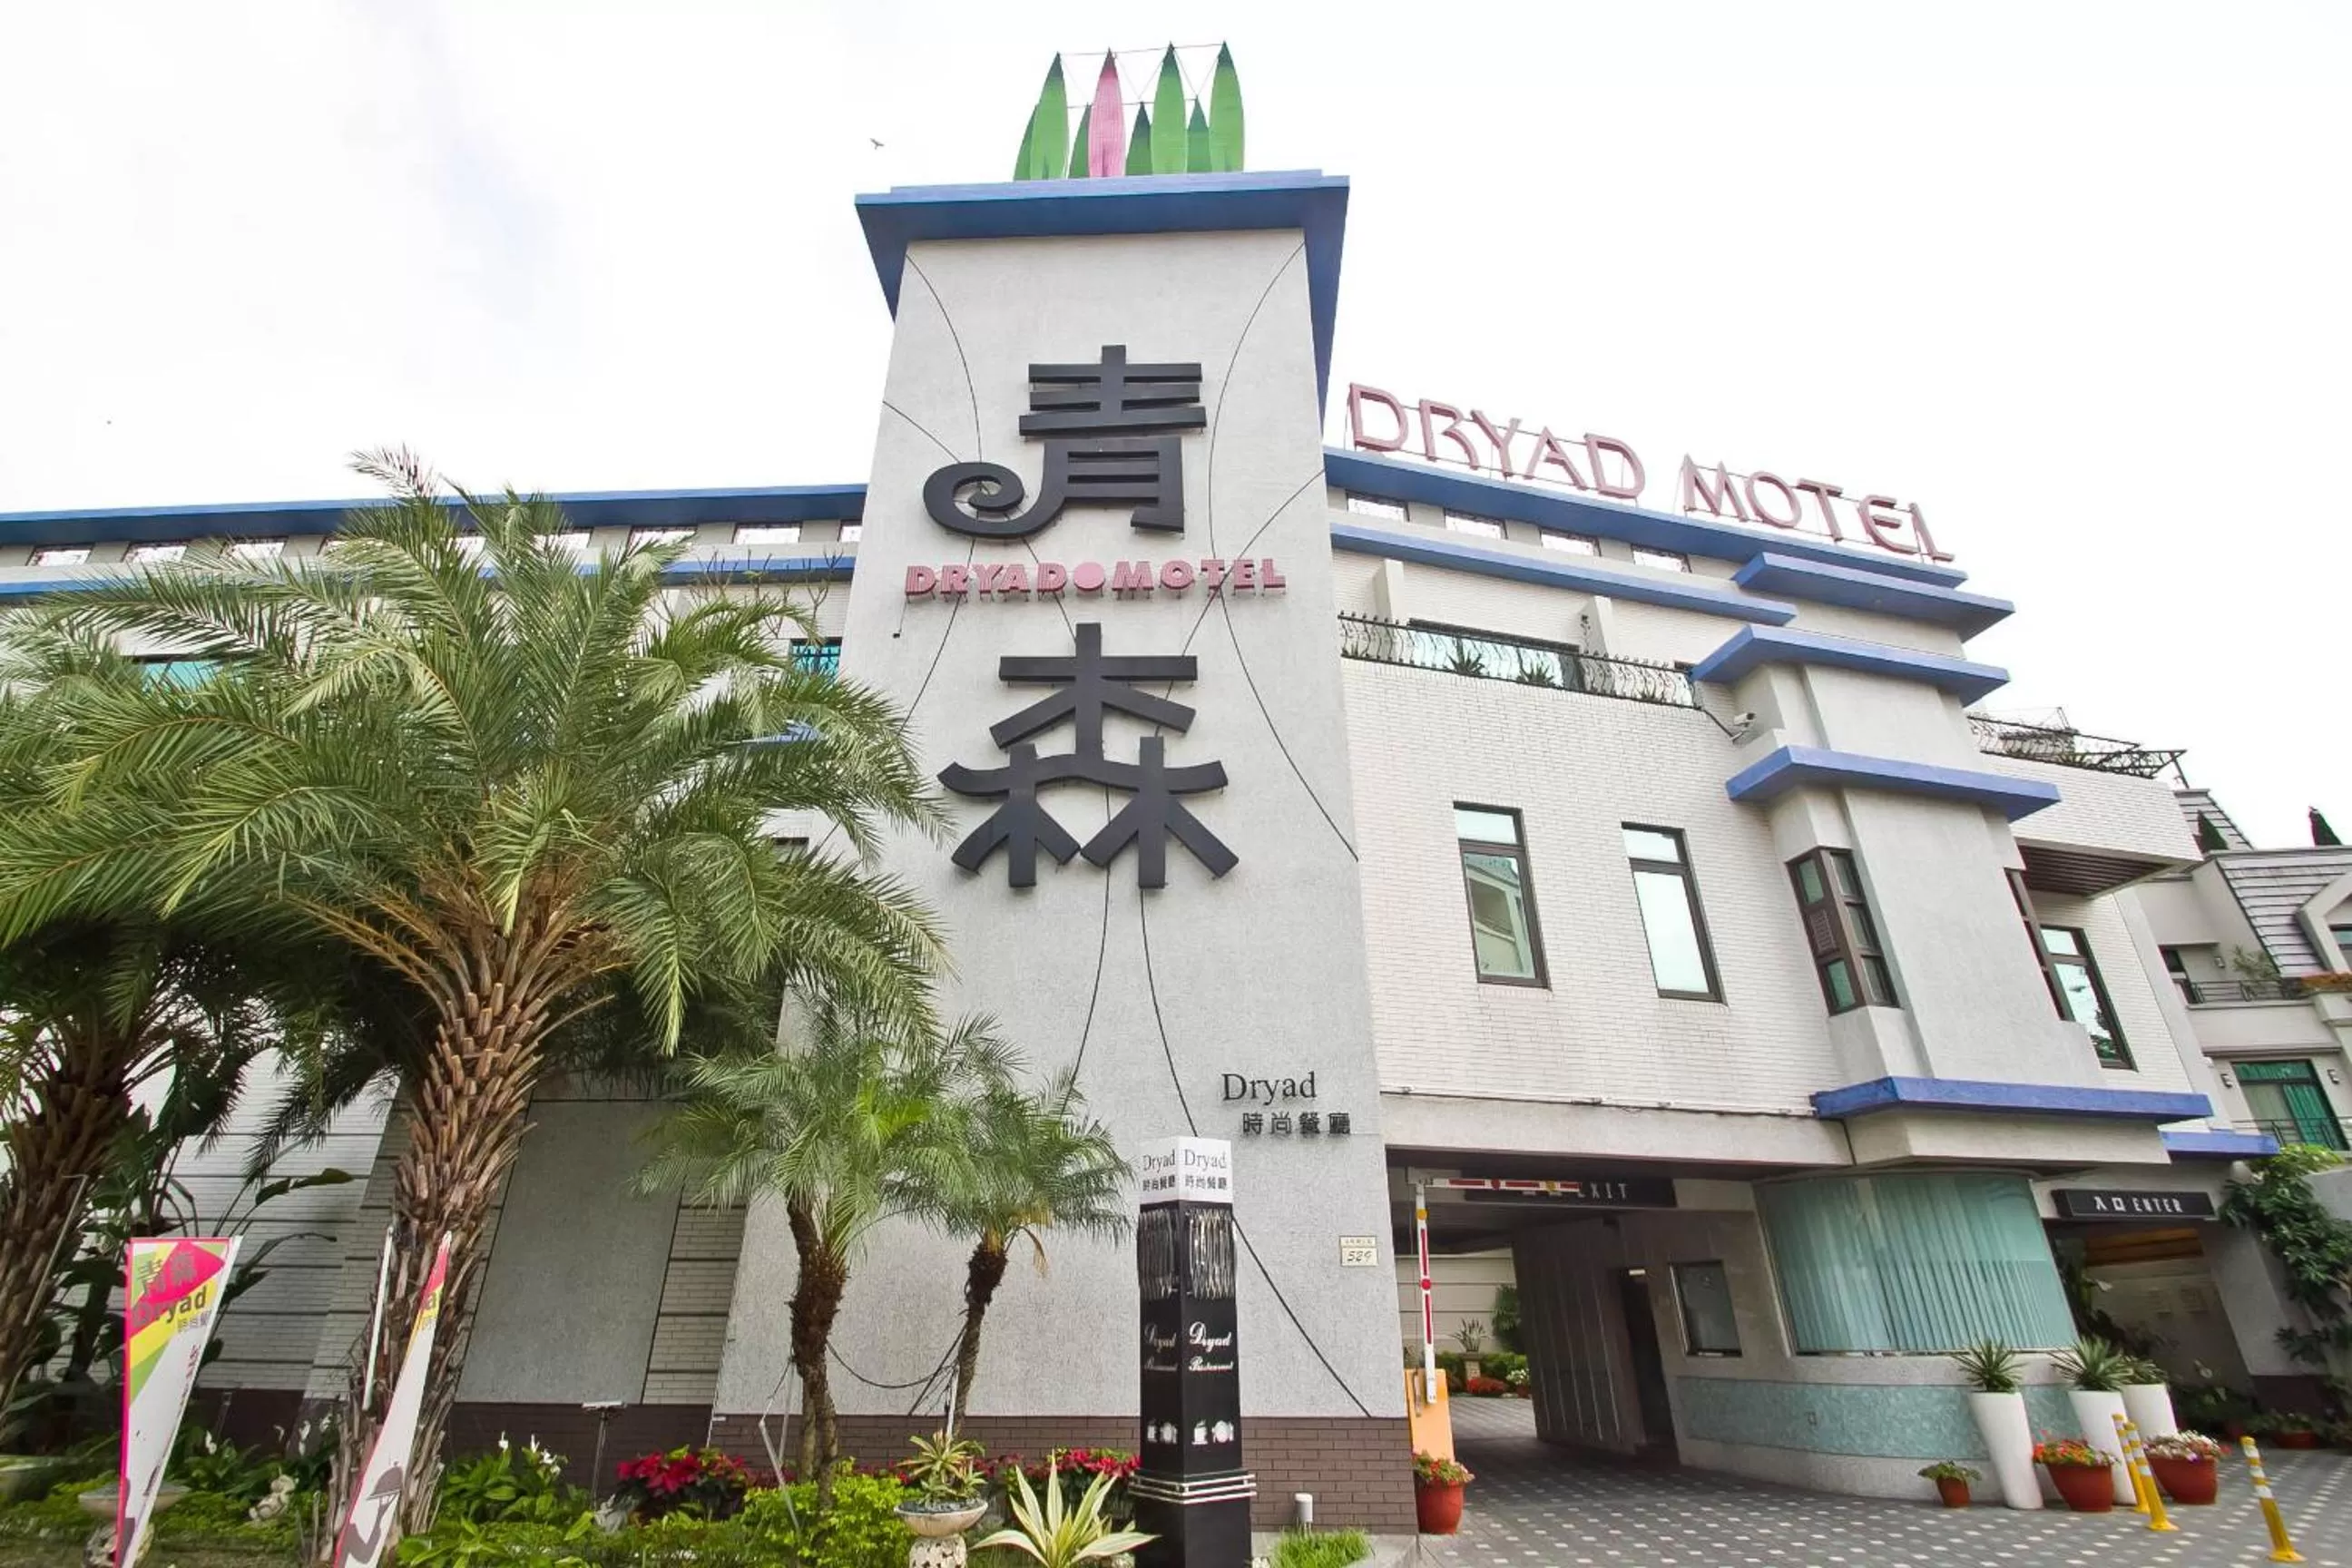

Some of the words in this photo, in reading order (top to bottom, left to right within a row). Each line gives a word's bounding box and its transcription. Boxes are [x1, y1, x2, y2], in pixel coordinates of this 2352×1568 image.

[1348, 382, 1646, 500] DRYAD
[1682, 454, 1955, 564] MOTEL
[906, 564, 1068, 595] DRYAD
[1112, 558, 1287, 595] MOTEL
[1221, 1071, 1318, 1106] Dryad
[1242, 1111, 1351, 1135] 時尚餐廳
[1142, 1149, 1176, 1173] Dryad
[1184, 1149, 1228, 1171] Dryad
[2093, 1196, 2126, 1212] 入口
[2132, 1197, 2184, 1213] ENTER
[132, 1285, 207, 1329] Dryad
[1189, 1321, 1232, 1353] Dryad
